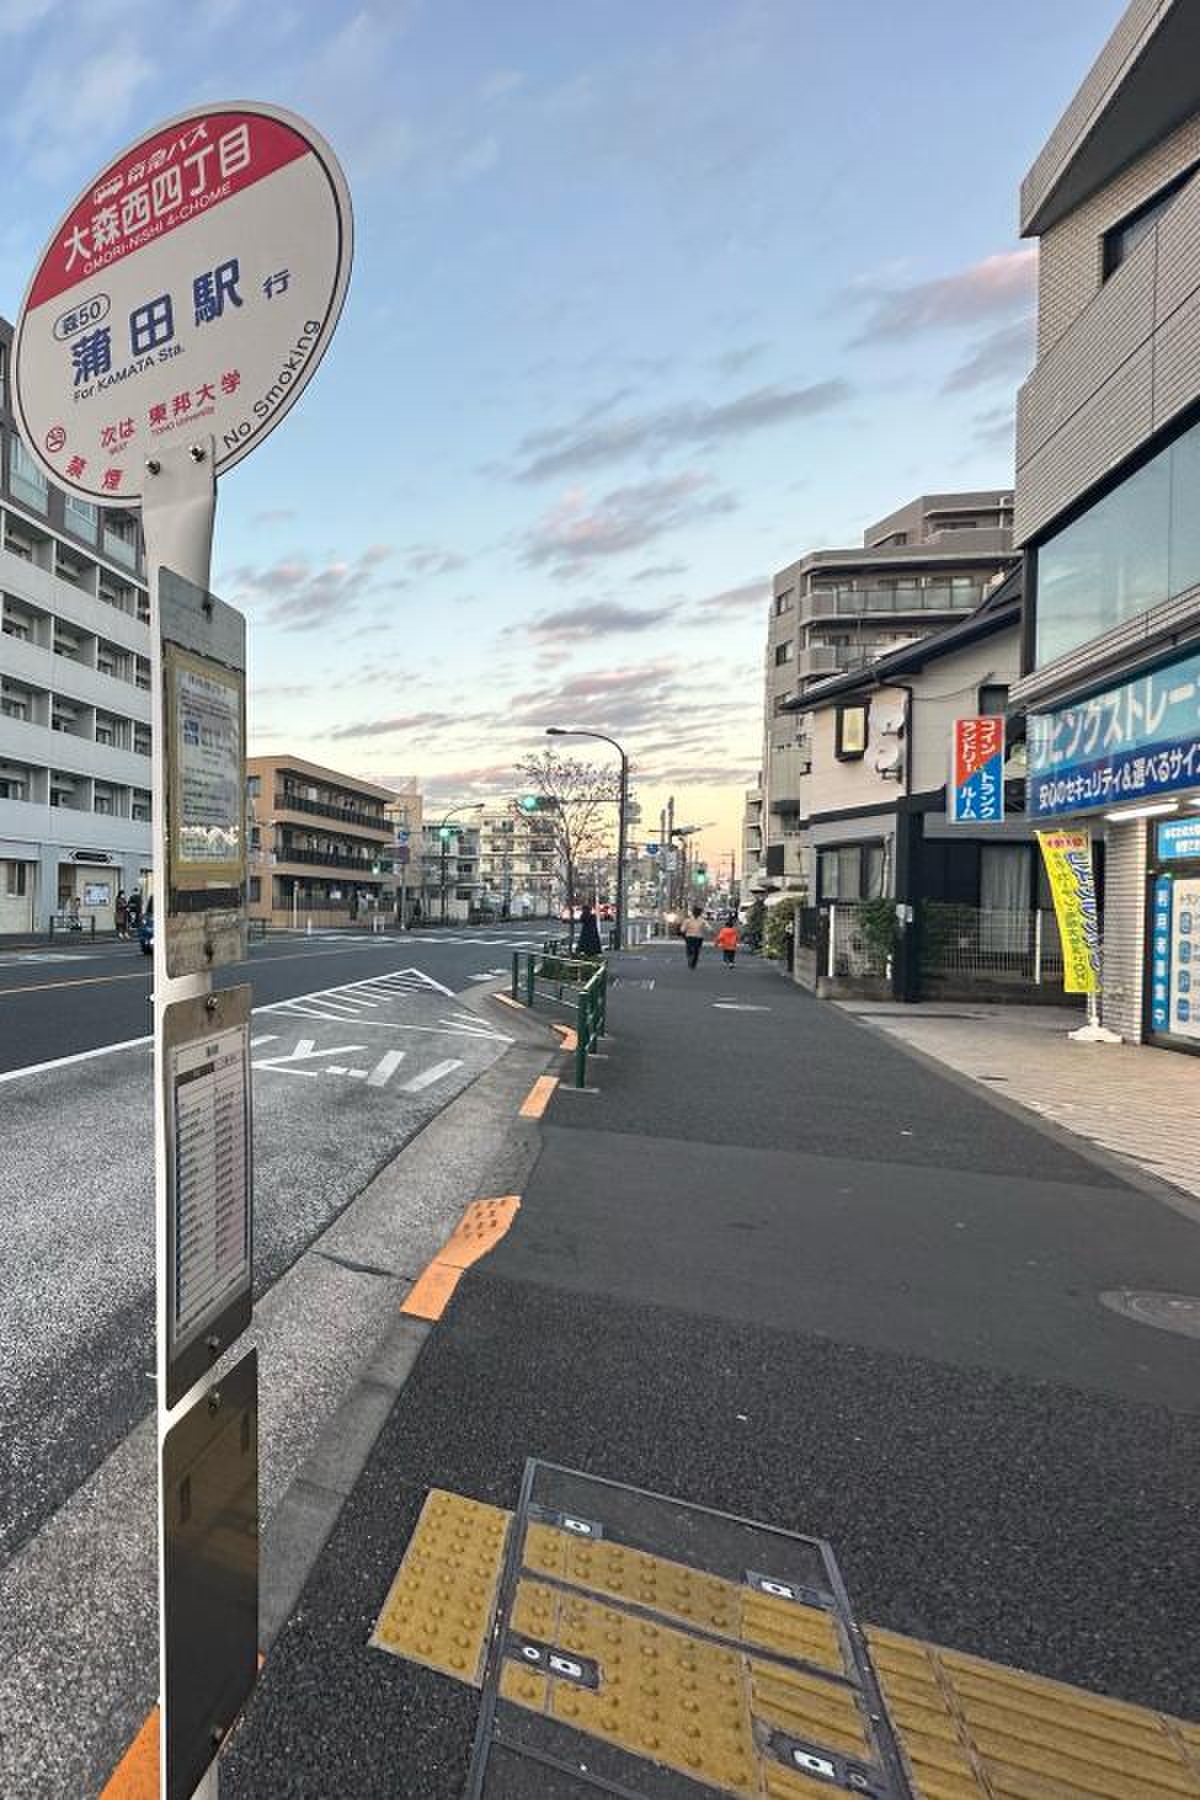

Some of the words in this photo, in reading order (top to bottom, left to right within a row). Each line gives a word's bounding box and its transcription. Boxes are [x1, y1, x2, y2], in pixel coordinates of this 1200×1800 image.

[63, 123, 250, 272] 大森西四丁目
[71, 258, 243, 386] 蒲田駅
[263, 269, 292, 299] 行
[73, 385, 95, 402] For
[98, 356, 154, 389] KAMATA
[101, 417, 135, 448] 次は
[148, 370, 240, 427] 東邦大学
[223, 421, 252, 449] No
[253, 320, 321, 418] Smoking
[1034, 674, 1200, 768] リビングストレー
[960, 786, 977, 818] ルーム
[980, 771, 995, 818] トランク
[1039, 743, 1200, 810] 安心のセキュリティ&選べるサイ
